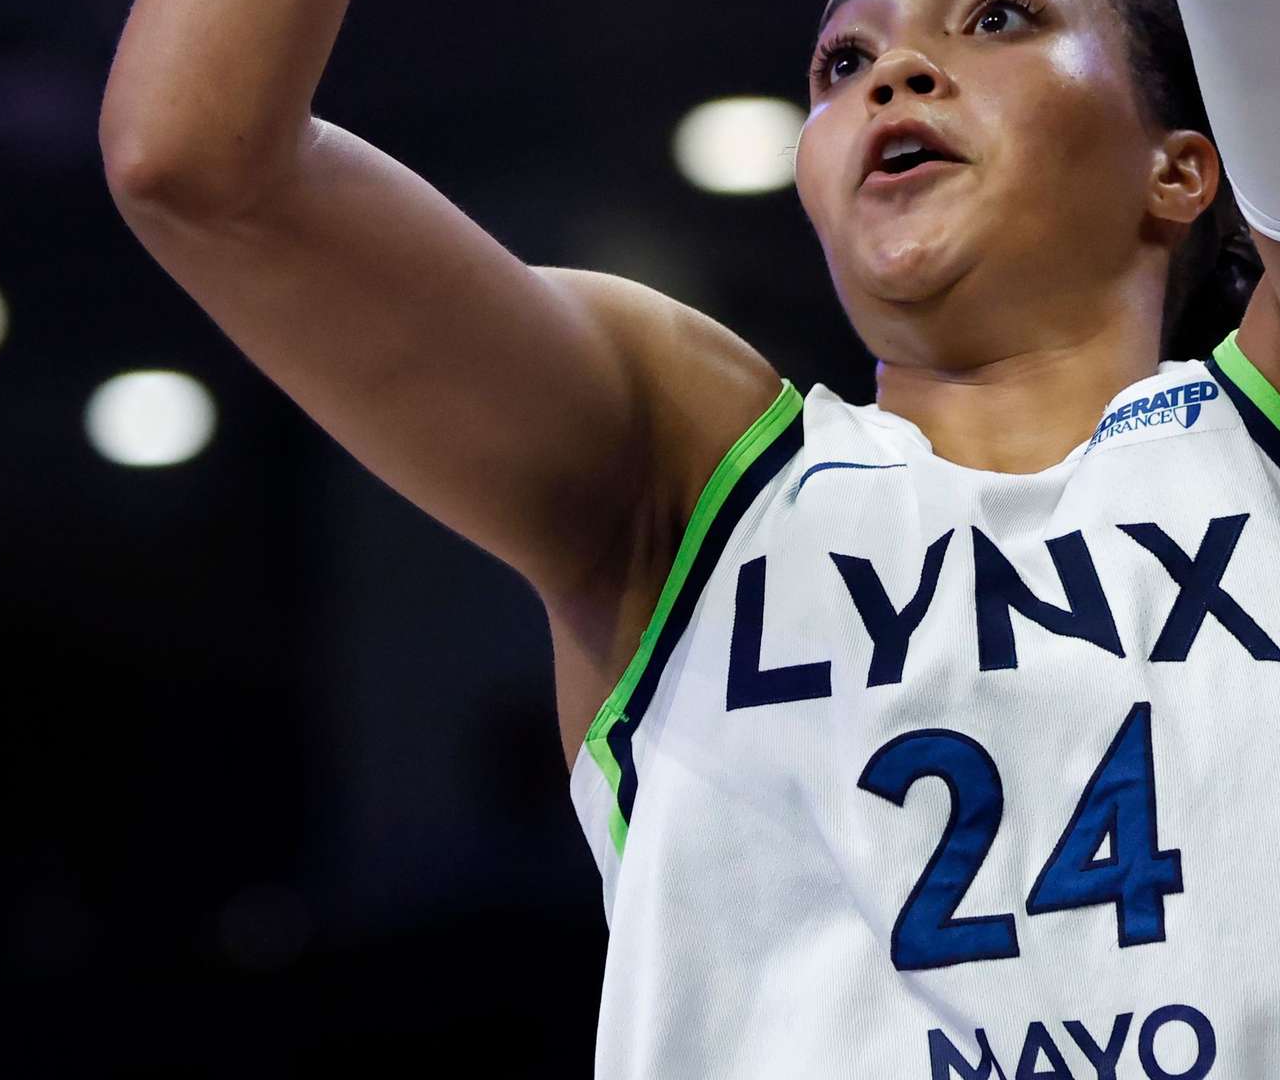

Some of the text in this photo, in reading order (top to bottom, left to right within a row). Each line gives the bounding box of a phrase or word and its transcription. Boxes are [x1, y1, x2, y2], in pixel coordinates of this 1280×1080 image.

[1084, 408, 1174, 454] SURANCE
[1092, 381, 1219, 439] DERATED
[857, 701, 1184, 971] 24
[927, 1003, 1217, 1080] MAYO
